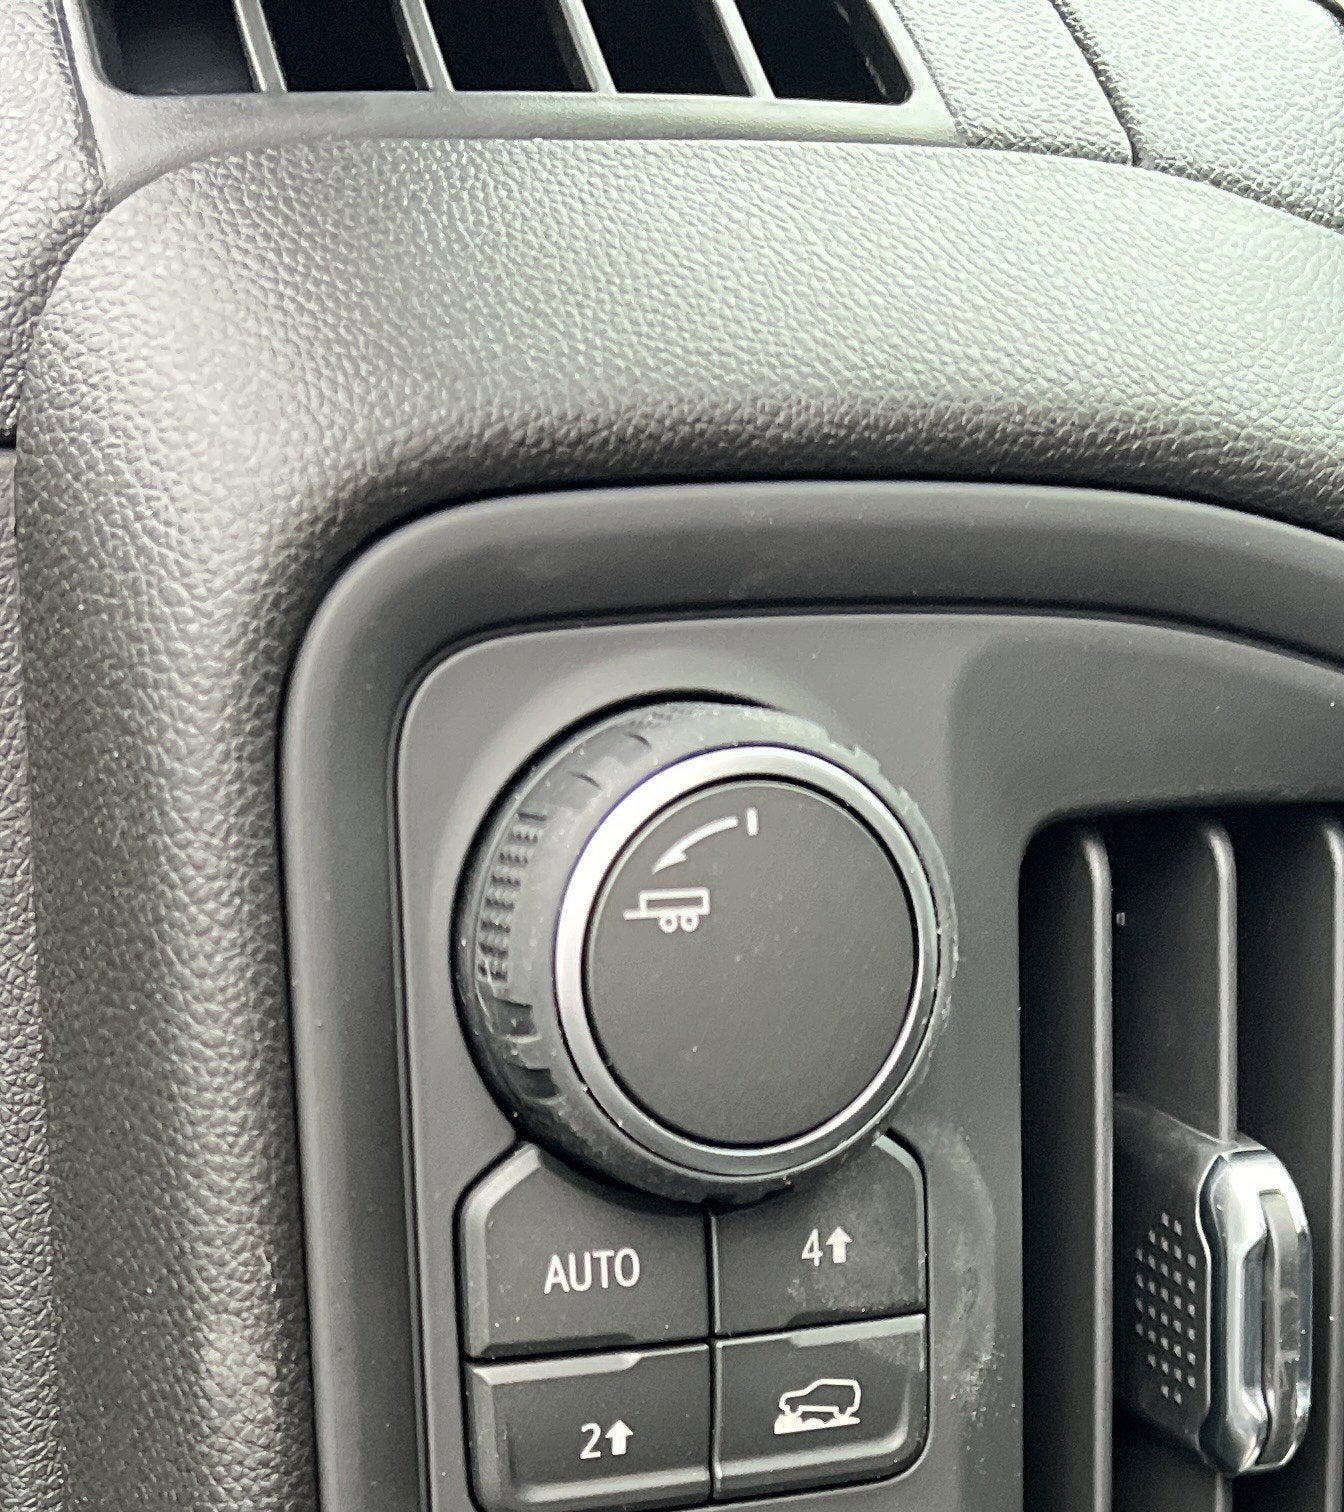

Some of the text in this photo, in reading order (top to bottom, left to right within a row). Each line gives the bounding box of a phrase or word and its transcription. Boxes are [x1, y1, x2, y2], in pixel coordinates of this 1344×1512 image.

[802, 1229, 823, 1267] 4
[544, 1248, 640, 1294] AUTO
[579, 1423, 602, 1459] 2
